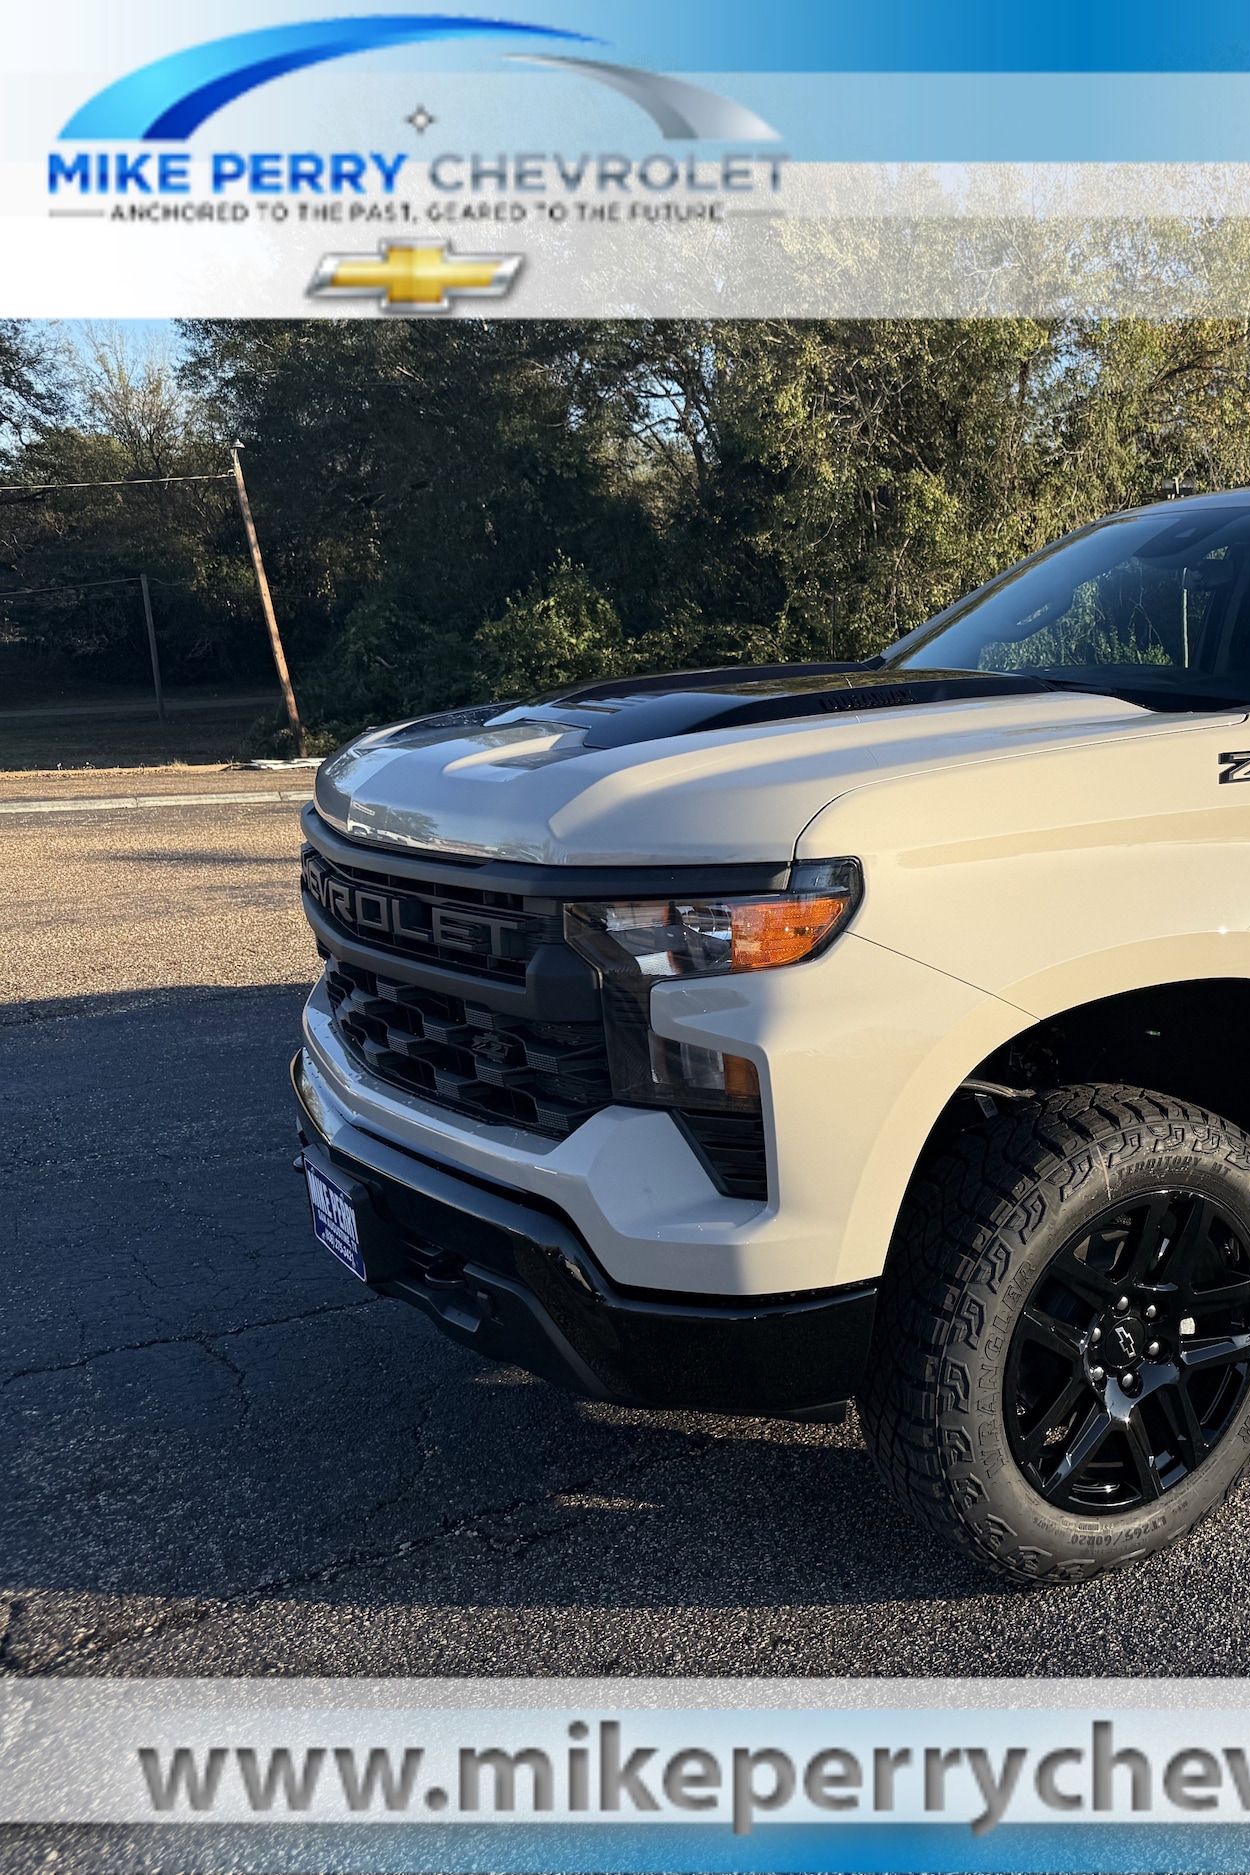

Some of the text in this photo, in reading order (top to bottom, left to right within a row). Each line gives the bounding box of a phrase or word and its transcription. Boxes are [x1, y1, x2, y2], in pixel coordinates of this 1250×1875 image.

[301, 849, 519, 956] HEVROLET
[1118, 1155, 1202, 1180] TERRITORY
[307, 1170, 359, 1245] MIKE PERRY
[976, 1259, 1037, 1480] WRANGLER
[1070, 1515, 1168, 1547] LT265/60R20
